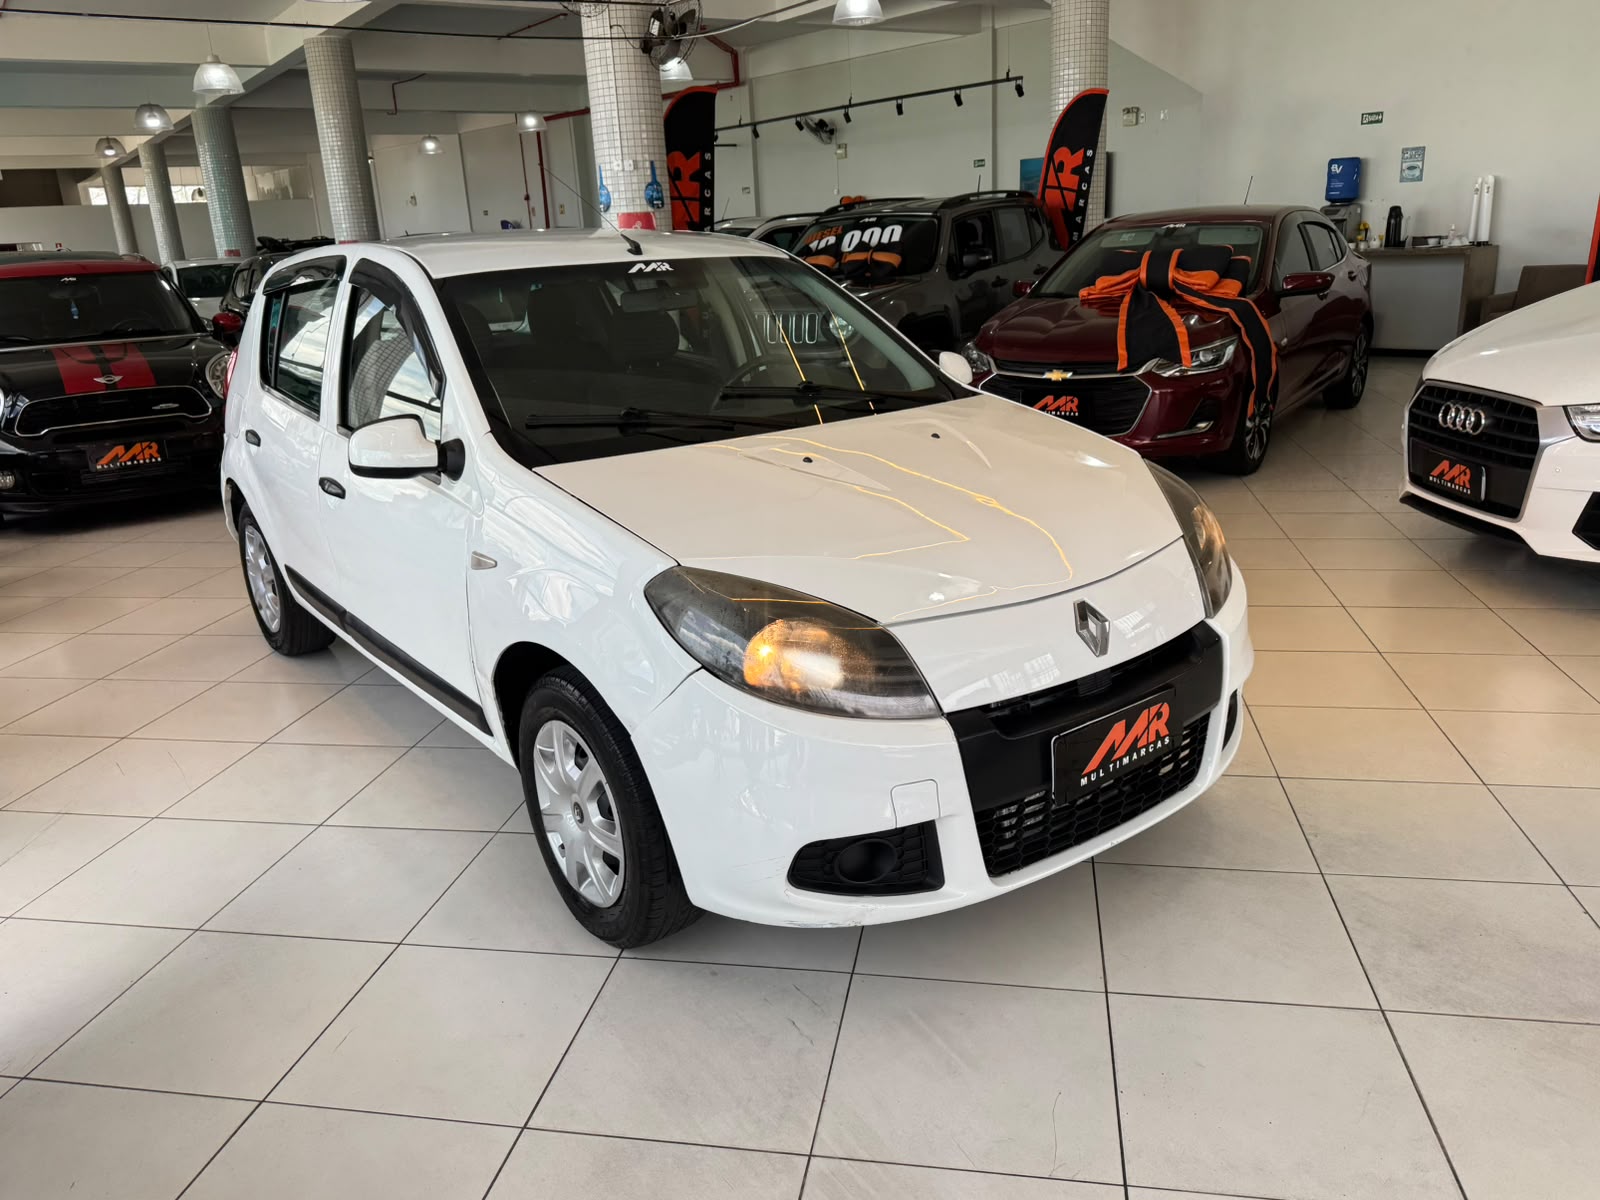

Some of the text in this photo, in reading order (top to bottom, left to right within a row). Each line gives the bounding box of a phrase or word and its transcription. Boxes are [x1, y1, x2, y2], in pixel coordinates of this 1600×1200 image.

[96, 441, 160, 466] MR
[1430, 459, 1471, 489] MR
[1082, 702, 1170, 776] MR
[1080, 736, 1170, 788] MULTIMARCAS
